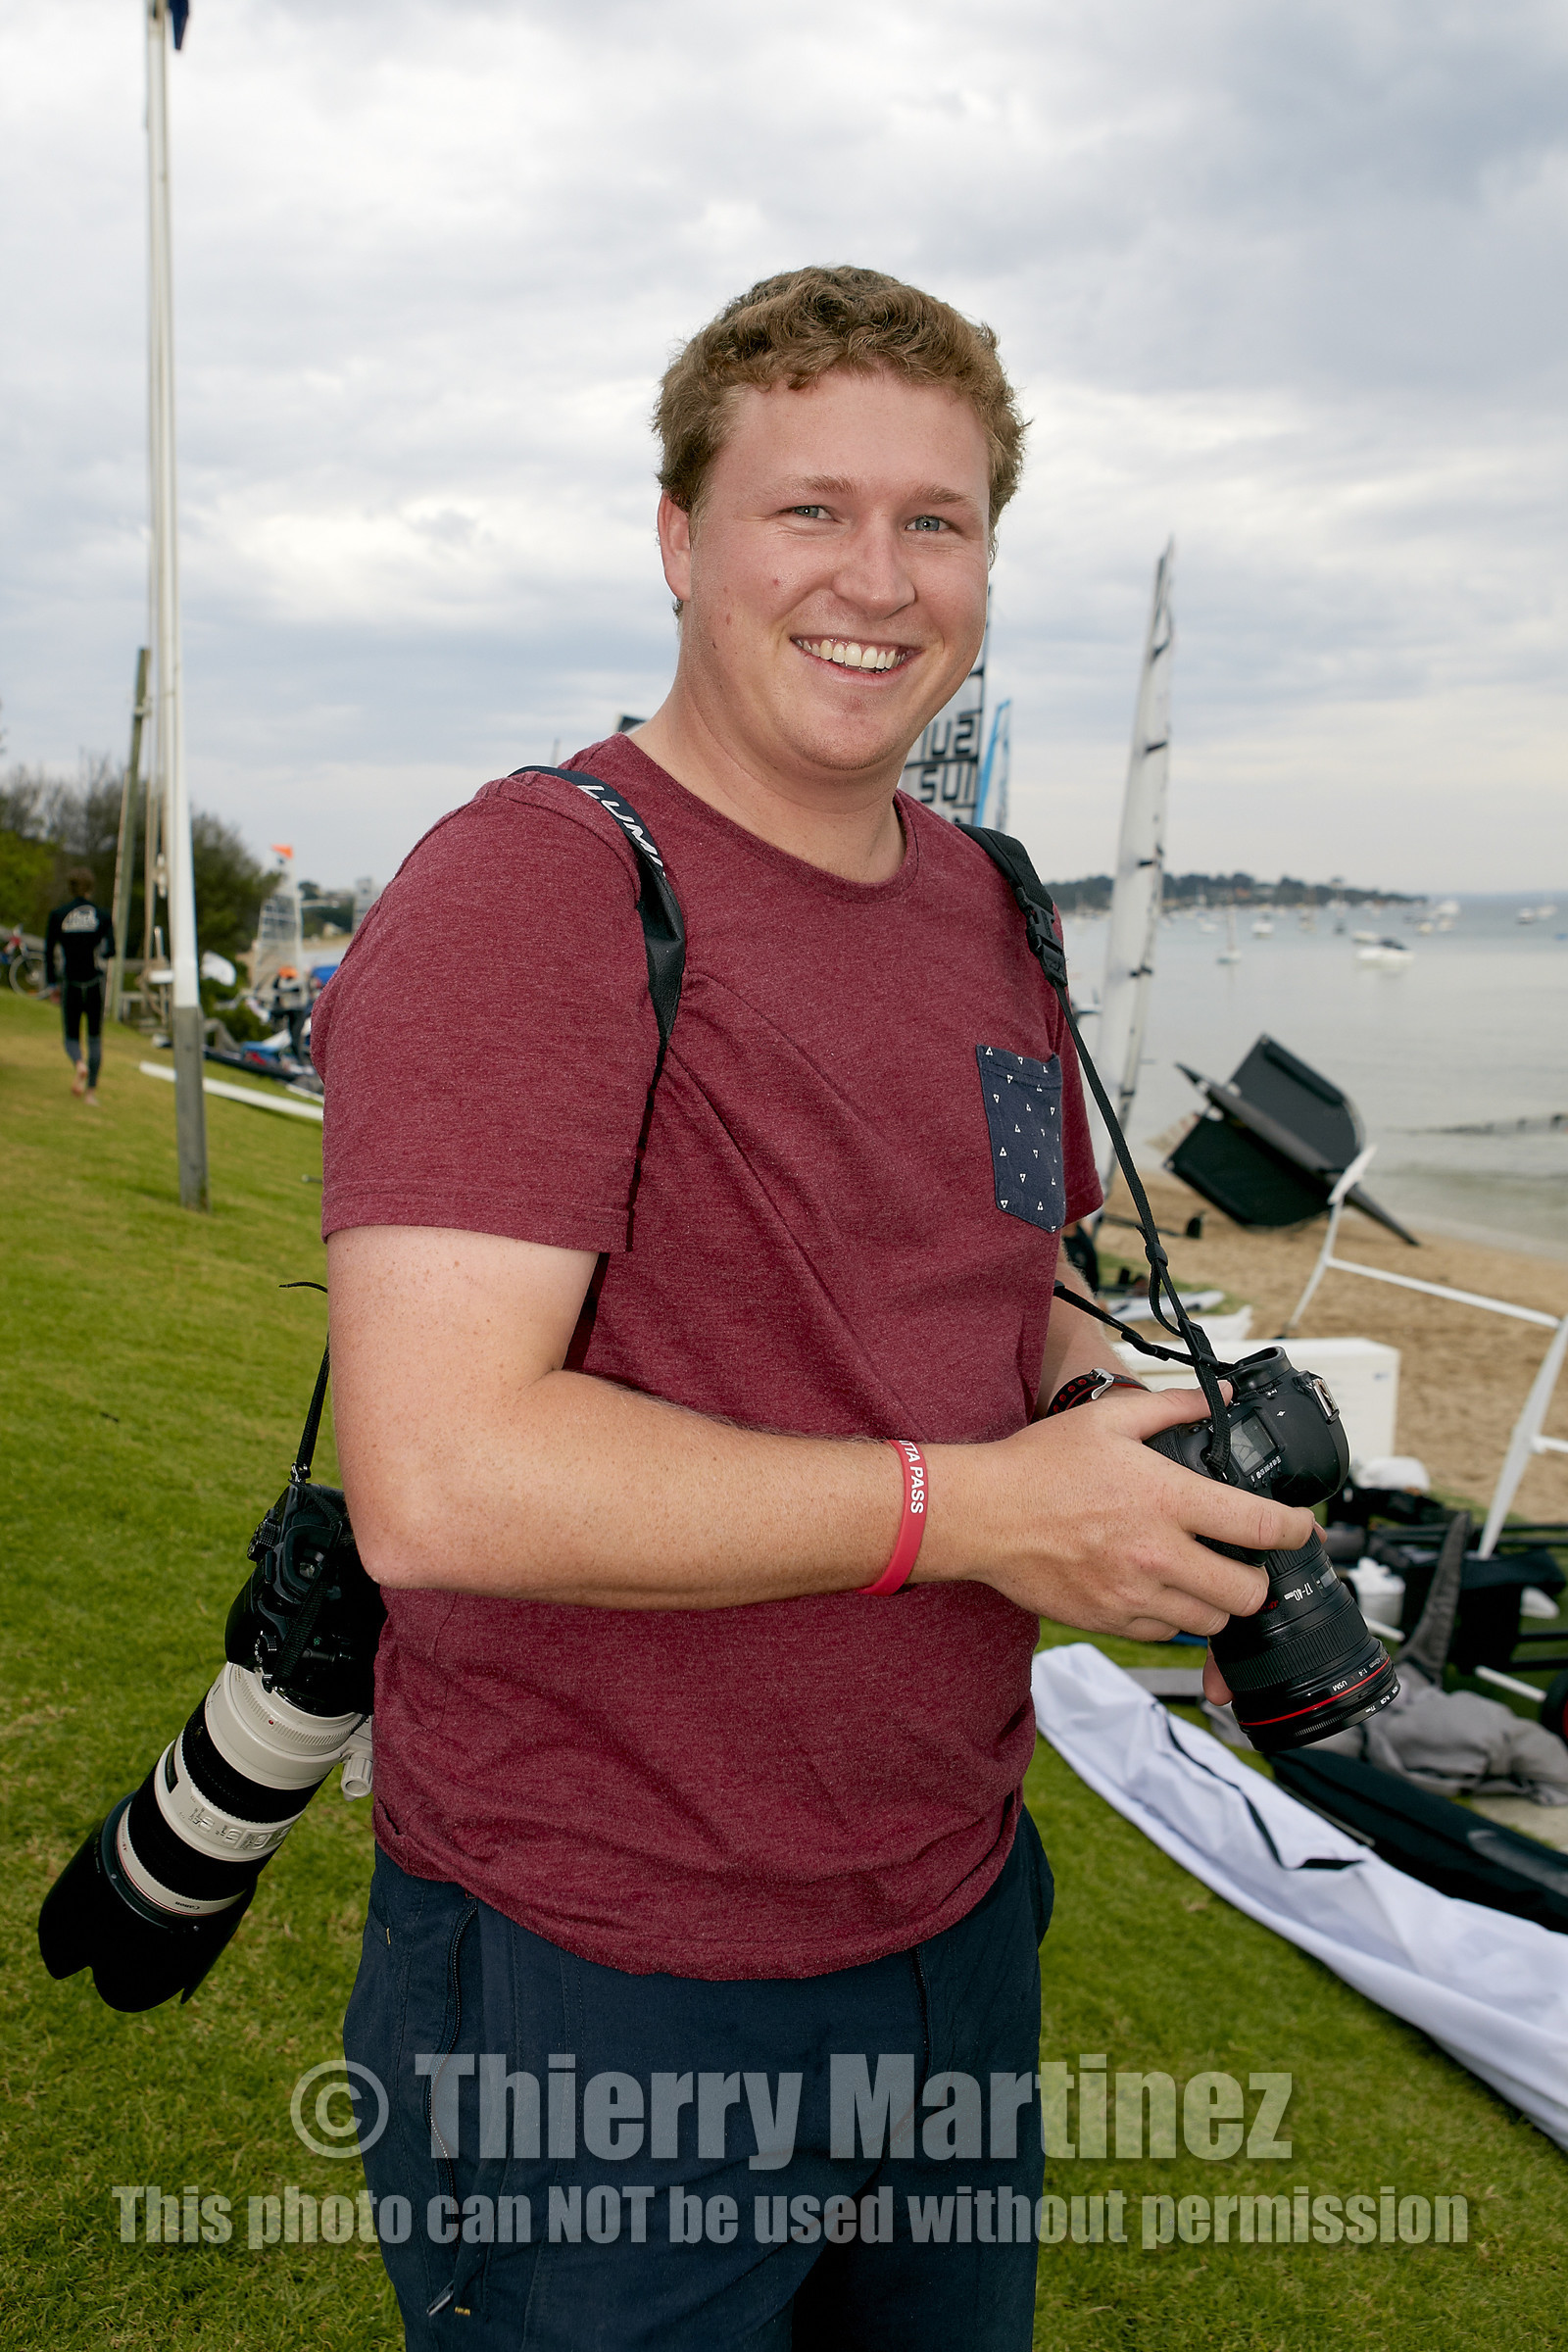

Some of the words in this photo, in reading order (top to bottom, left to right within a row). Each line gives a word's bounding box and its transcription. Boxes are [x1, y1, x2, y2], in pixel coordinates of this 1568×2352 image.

[577, 784, 666, 876] LUMI
[909, 1465, 924, 1514] PASS
[1332, 1680, 1348, 1691] USM
[174, 1901, 201, 1910] Canon
